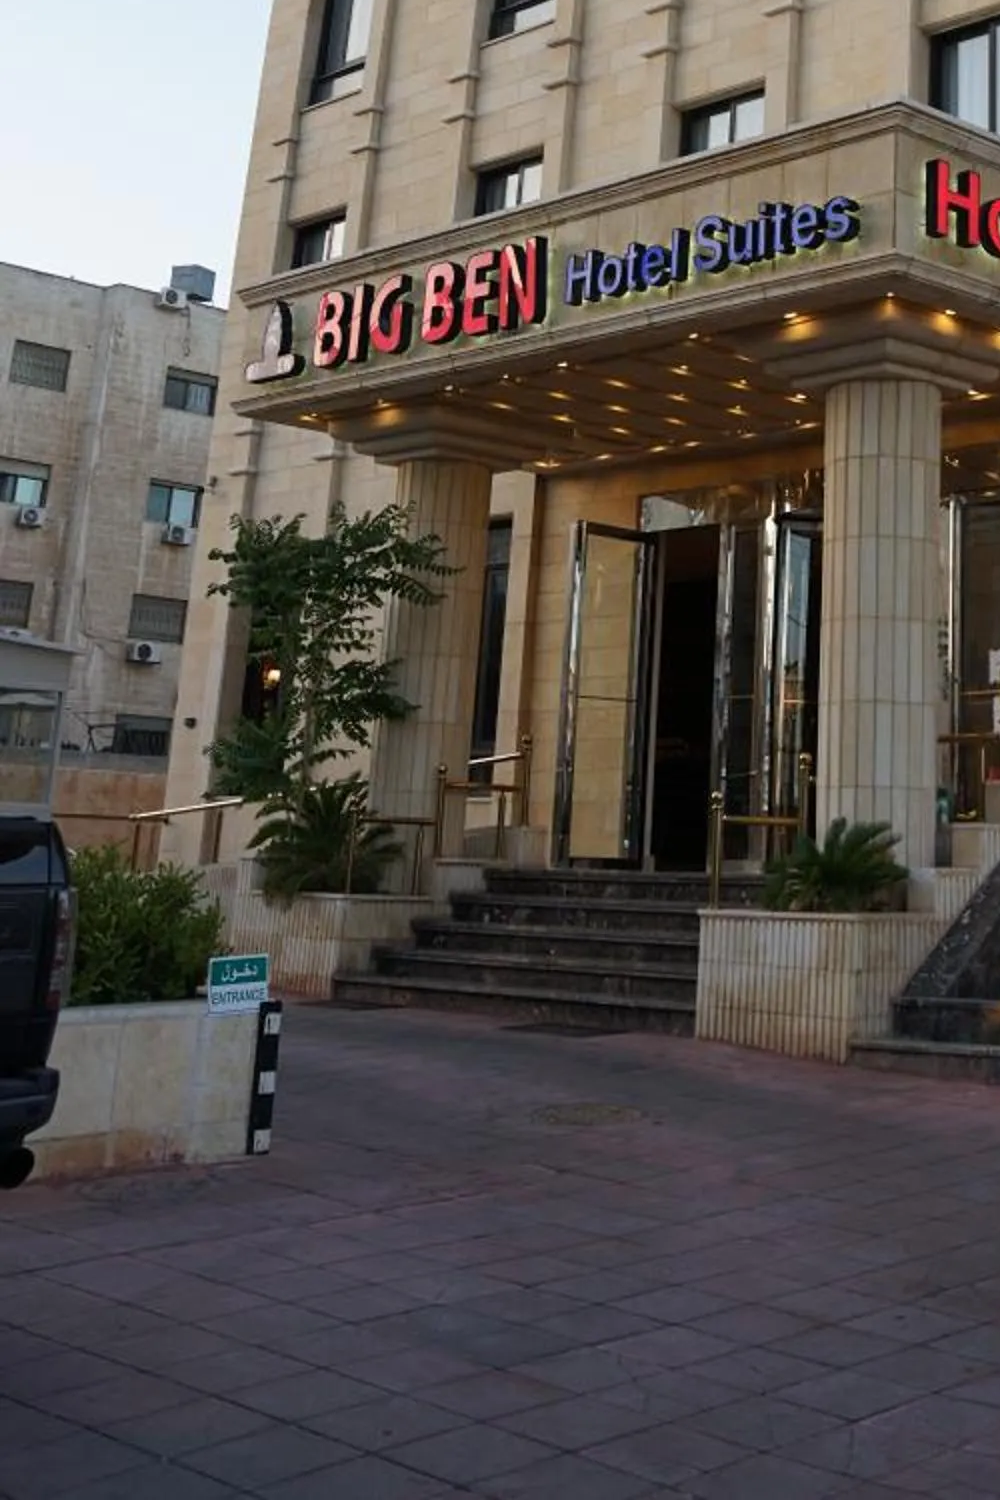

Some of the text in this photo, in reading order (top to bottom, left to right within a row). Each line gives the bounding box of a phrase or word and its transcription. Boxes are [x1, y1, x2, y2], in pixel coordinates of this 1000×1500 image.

[313, 196, 859, 367] BIG BEN Hotel Suites
[211, 988, 265, 1004] ENTRANCE
